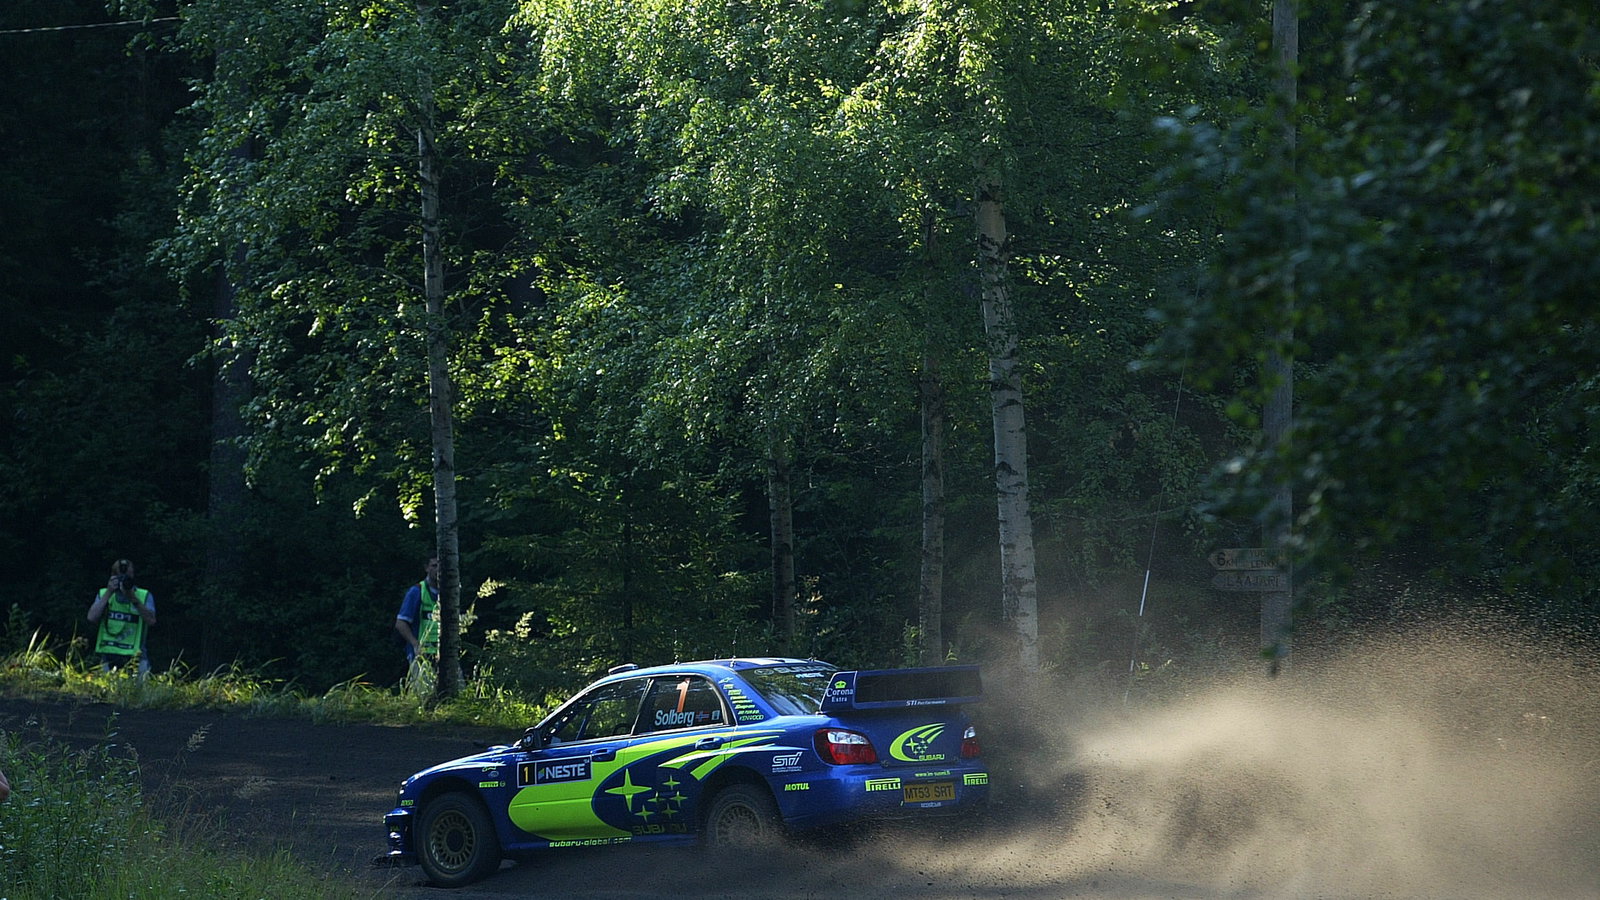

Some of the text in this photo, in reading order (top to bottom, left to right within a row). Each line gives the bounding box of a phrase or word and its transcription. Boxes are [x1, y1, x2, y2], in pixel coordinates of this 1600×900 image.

[1217, 552, 1226, 566] 6
[676, 678, 690, 713] 1
[826, 688, 854, 697] Corona
[654, 709, 695, 727] Solberg
[523, 763, 586, 783] 1 NESTE
[963, 773, 988, 786] PIRELLI
[784, 782, 810, 791] MOTUL
[865, 778, 901, 792] PIRELLI
[904, 784, 953, 800] MT53 SRT
